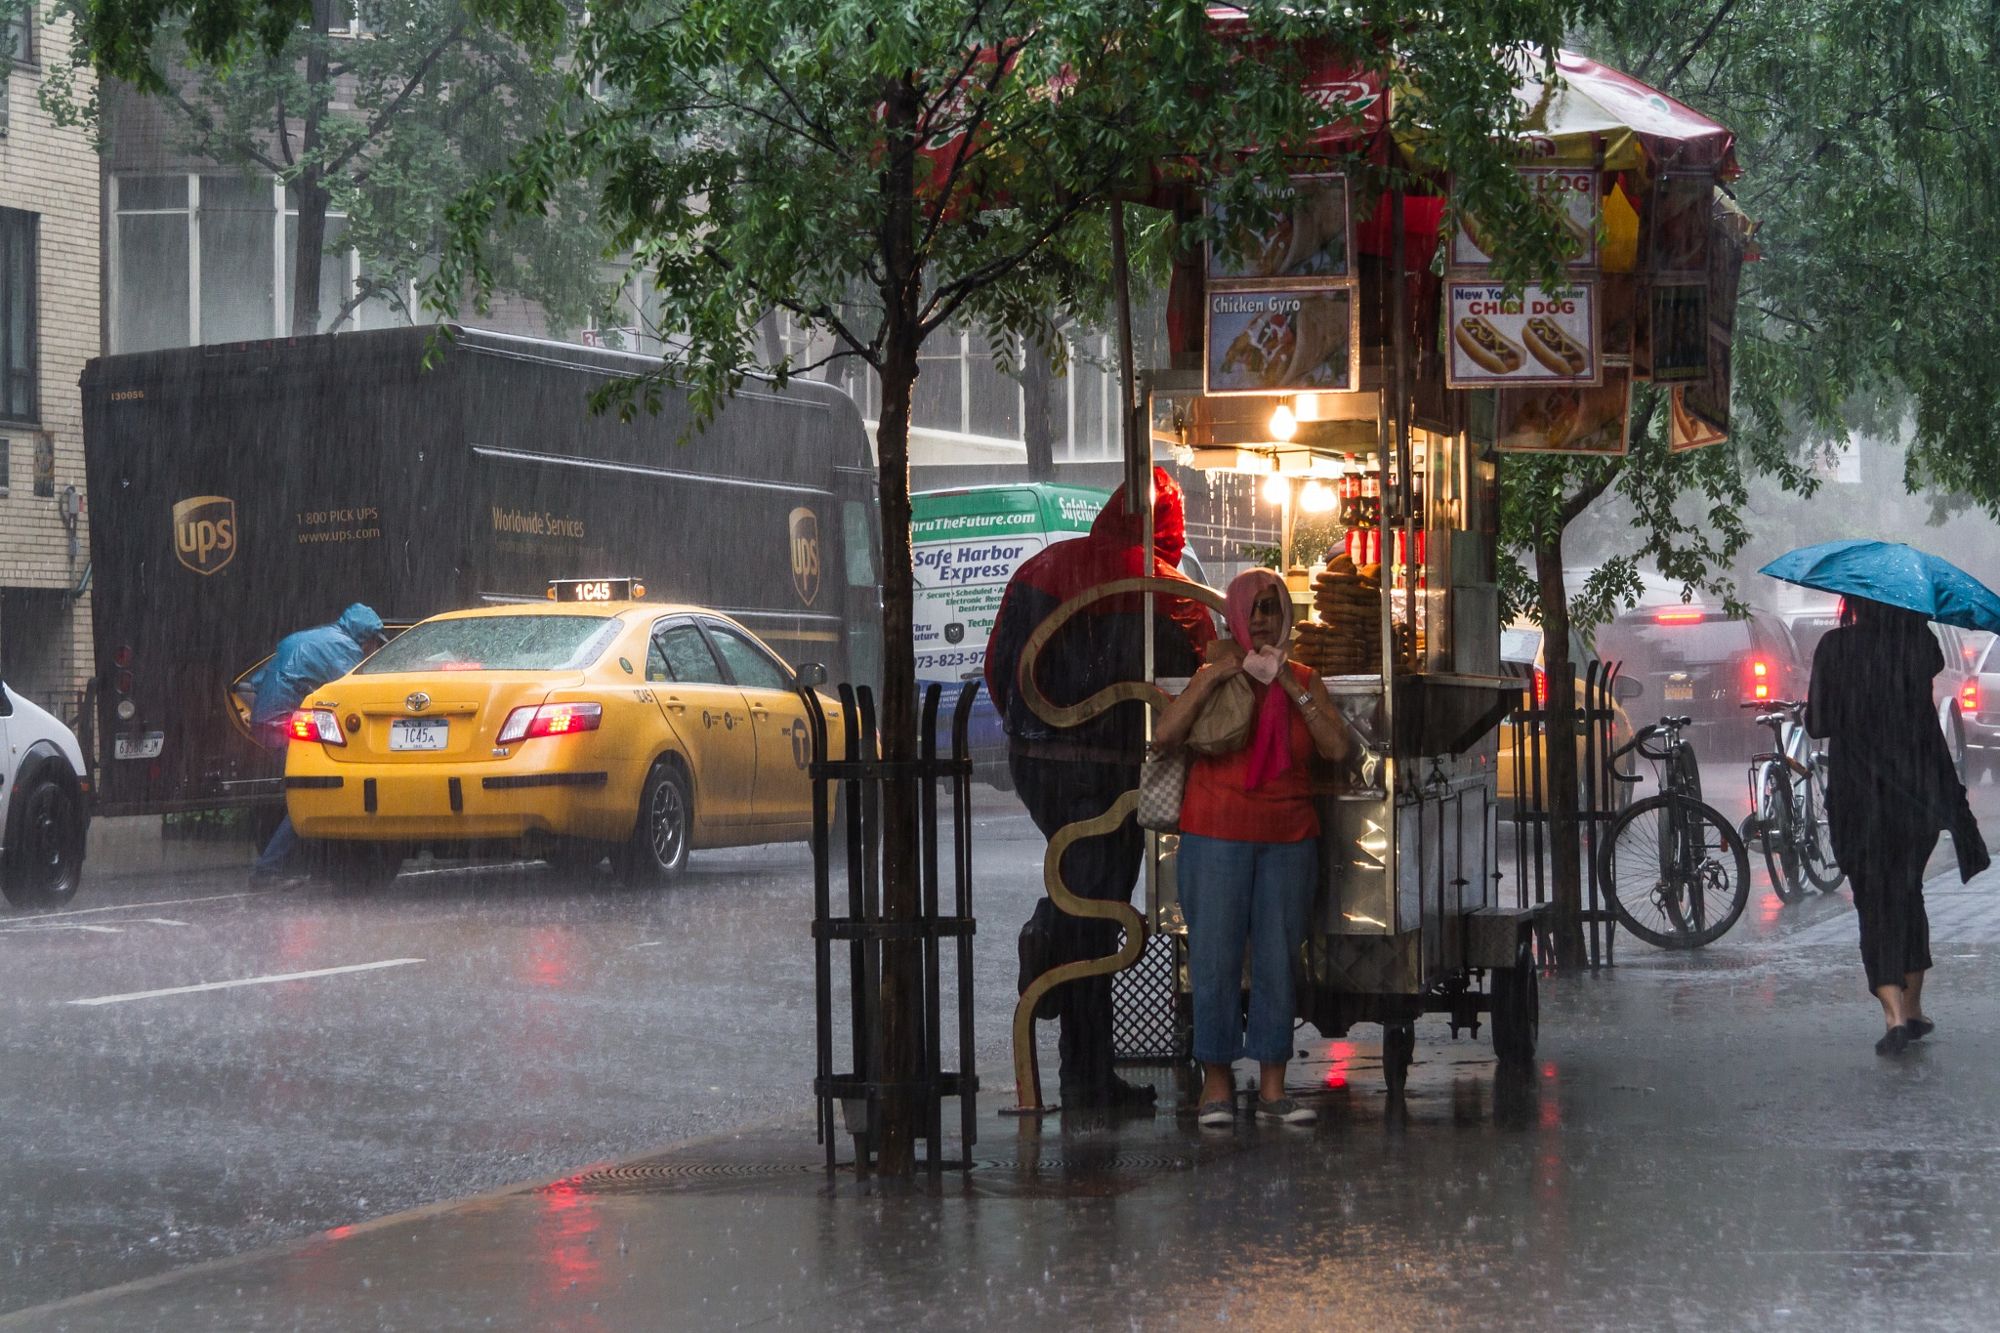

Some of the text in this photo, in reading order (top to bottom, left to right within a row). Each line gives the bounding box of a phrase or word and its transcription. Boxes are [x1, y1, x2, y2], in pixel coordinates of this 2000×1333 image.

[1455, 289, 1483, 300] New
[1212, 296, 1301, 314] Chicken Gyro
[1532, 301, 1575, 315] DOG
[305, 511, 327, 525] 800
[329, 509, 354, 522] PICK
[357, 507, 378, 520] UPS
[492, 505, 585, 538] Worldwide Services
[178, 518, 233, 563] ups
[298, 527, 380, 544] www.ups.com
[793, 537, 818, 591] ups
[914, 545, 1024, 569] Safe Harbor
[939, 563, 1010, 583] Express
[575, 582, 610, 600] 1C45
[926, 591, 951, 600] Secure
[914, 632, 940, 641] uture
[913, 651, 986, 669] 73-823-97
